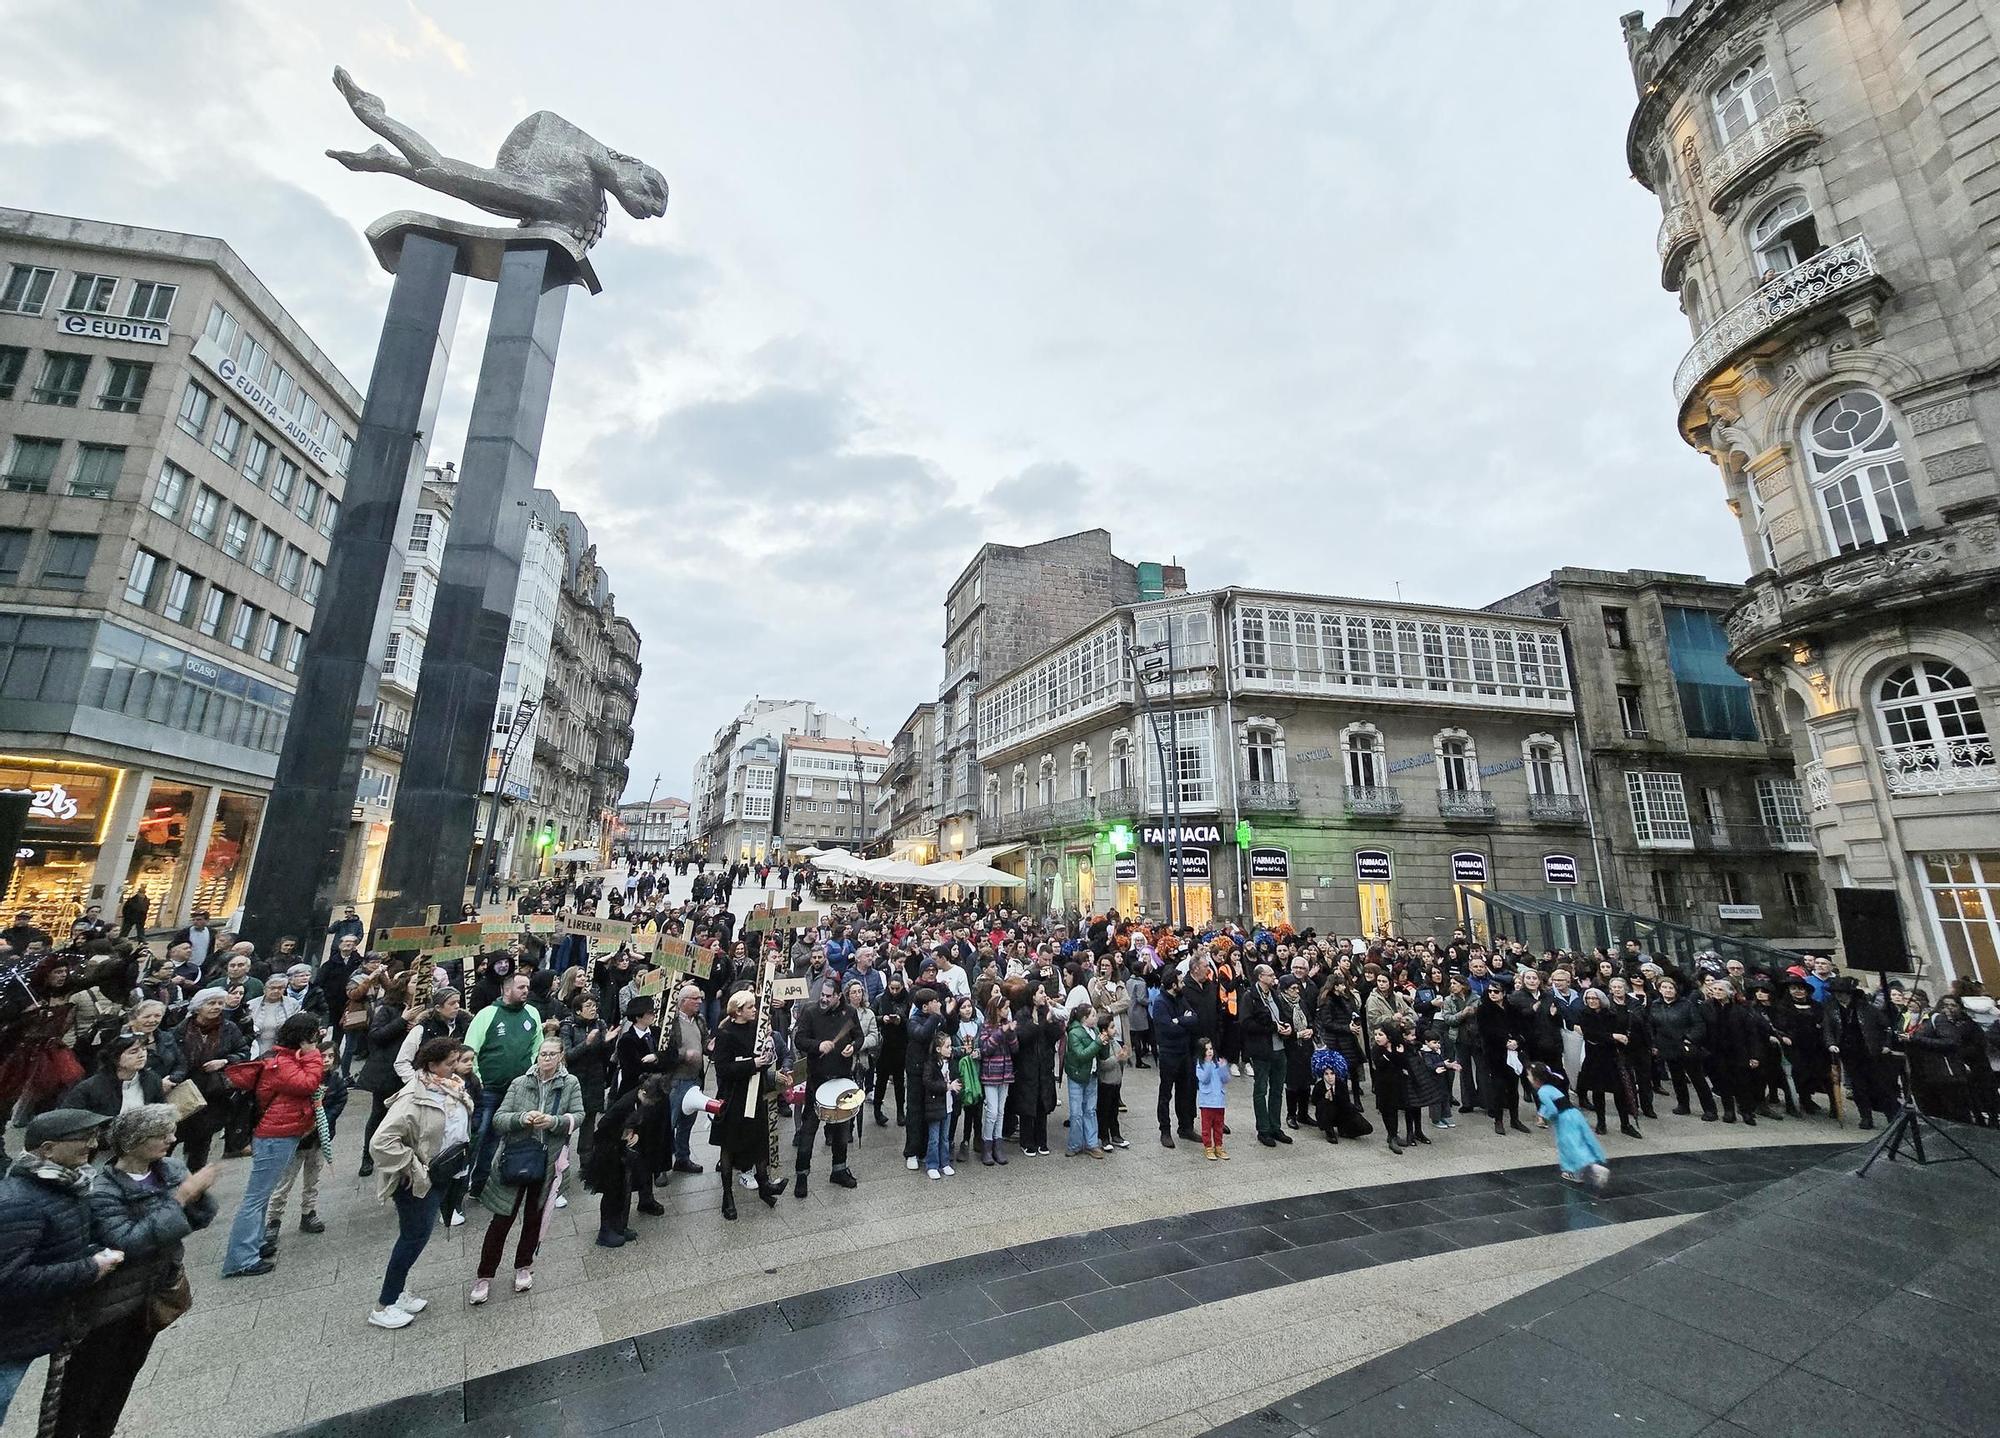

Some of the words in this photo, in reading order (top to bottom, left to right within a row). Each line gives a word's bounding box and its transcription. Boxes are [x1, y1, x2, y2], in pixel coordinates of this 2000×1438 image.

[91, 321, 162, 341] EUDITA
[236, 375, 278, 420] EUDITA
[285, 422, 326, 464] AUDITEC
[186, 660, 217, 679] OCASO
[1169, 857, 1206, 866] FAMACIA
[1253, 856, 1286, 865] FARMACIA
[1360, 858, 1388, 866] FARMACIA
[1455, 860, 1483, 869] FARMACIA
[1547, 862, 1574, 871] FARMACIA
[567, 918, 602, 933] LIBERAR
[379, 929, 389, 941] A
[430, 924, 447, 936] FAI
[443, 935, 452, 947] E
[656, 936, 663, 951] A
[690, 960, 697, 973] E
